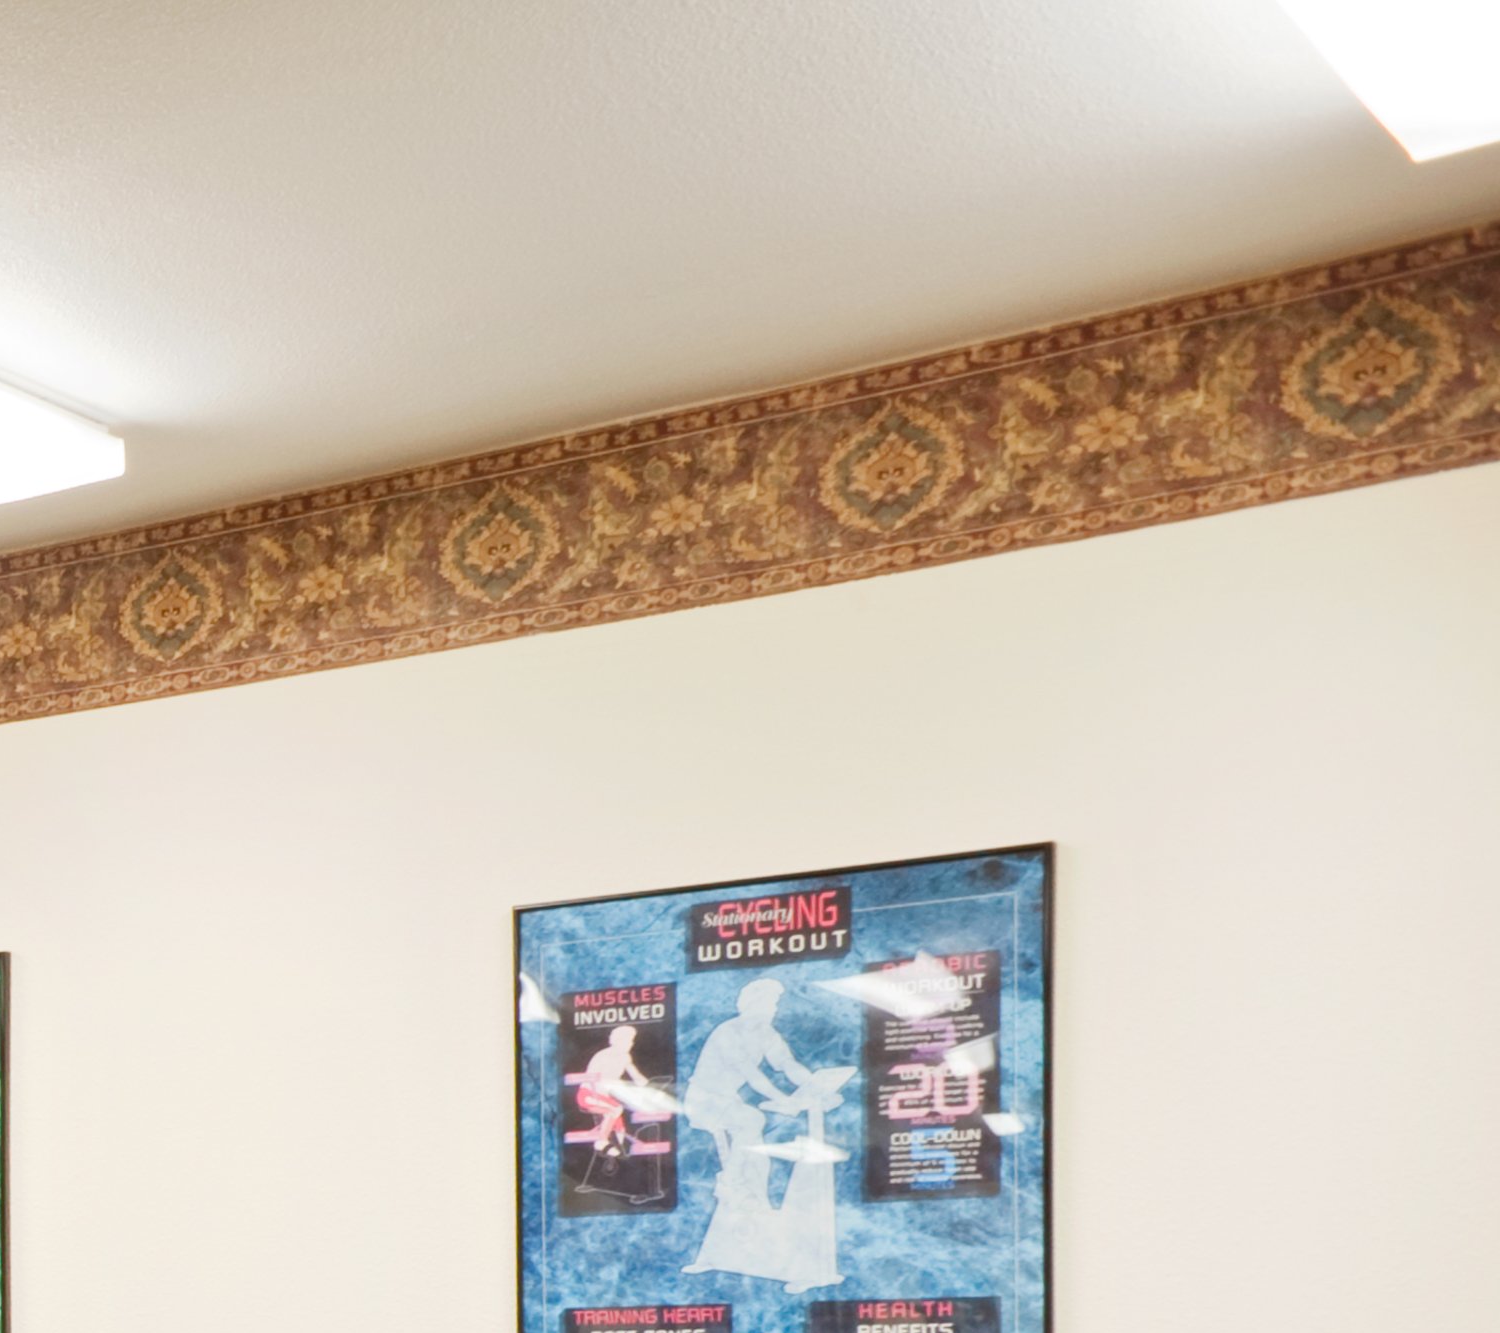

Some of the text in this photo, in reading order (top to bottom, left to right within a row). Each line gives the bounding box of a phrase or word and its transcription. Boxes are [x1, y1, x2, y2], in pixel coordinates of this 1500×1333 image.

[701, 905, 794, 932] Stationary
[718, 889, 838, 943] CYCLING
[697, 929, 848, 962] WORKOUT
[573, 985, 667, 1009] MUSCLES
[573, 1003, 666, 1027] INVOLVED
[888, 1062, 980, 1120] 20
[890, 1128, 982, 1146] COOL-DOWN
[572, 1305, 725, 1327] TRAINING HEART
[858, 1300, 954, 1319] HEALTH
